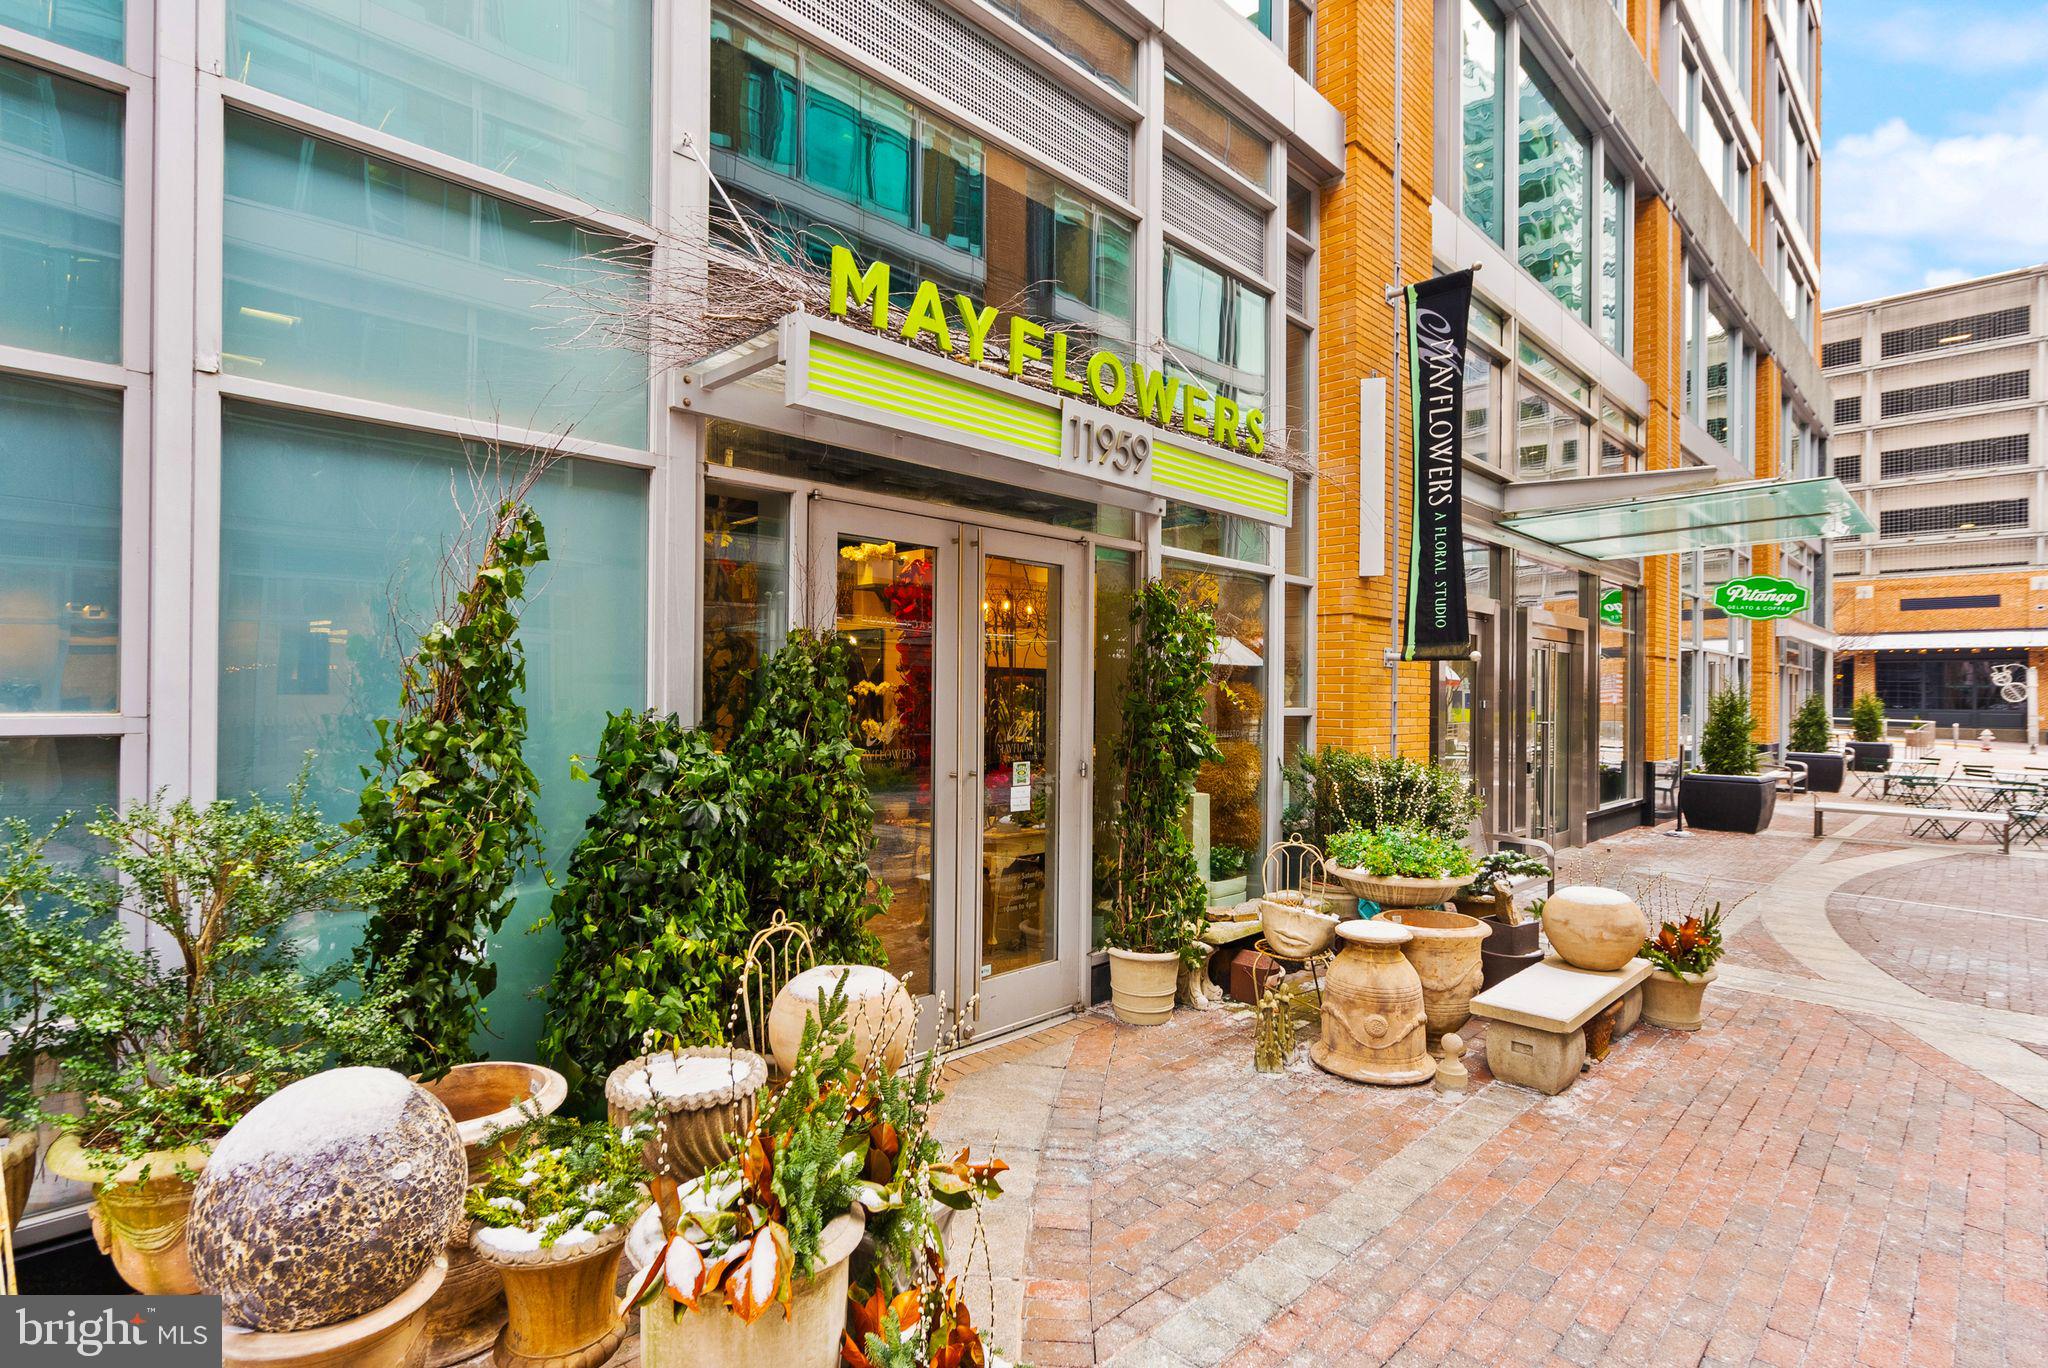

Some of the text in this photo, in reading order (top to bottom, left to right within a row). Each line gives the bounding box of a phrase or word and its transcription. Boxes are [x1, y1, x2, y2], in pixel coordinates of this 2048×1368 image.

[830, 244, 1265, 455] MAYFLOWERS
[1069, 414, 1150, 475] 11959
[1428, 338, 1454, 628] MAYFLOWERS A FLORAL STUDIO
[1726, 584, 1798, 606] Pitango
